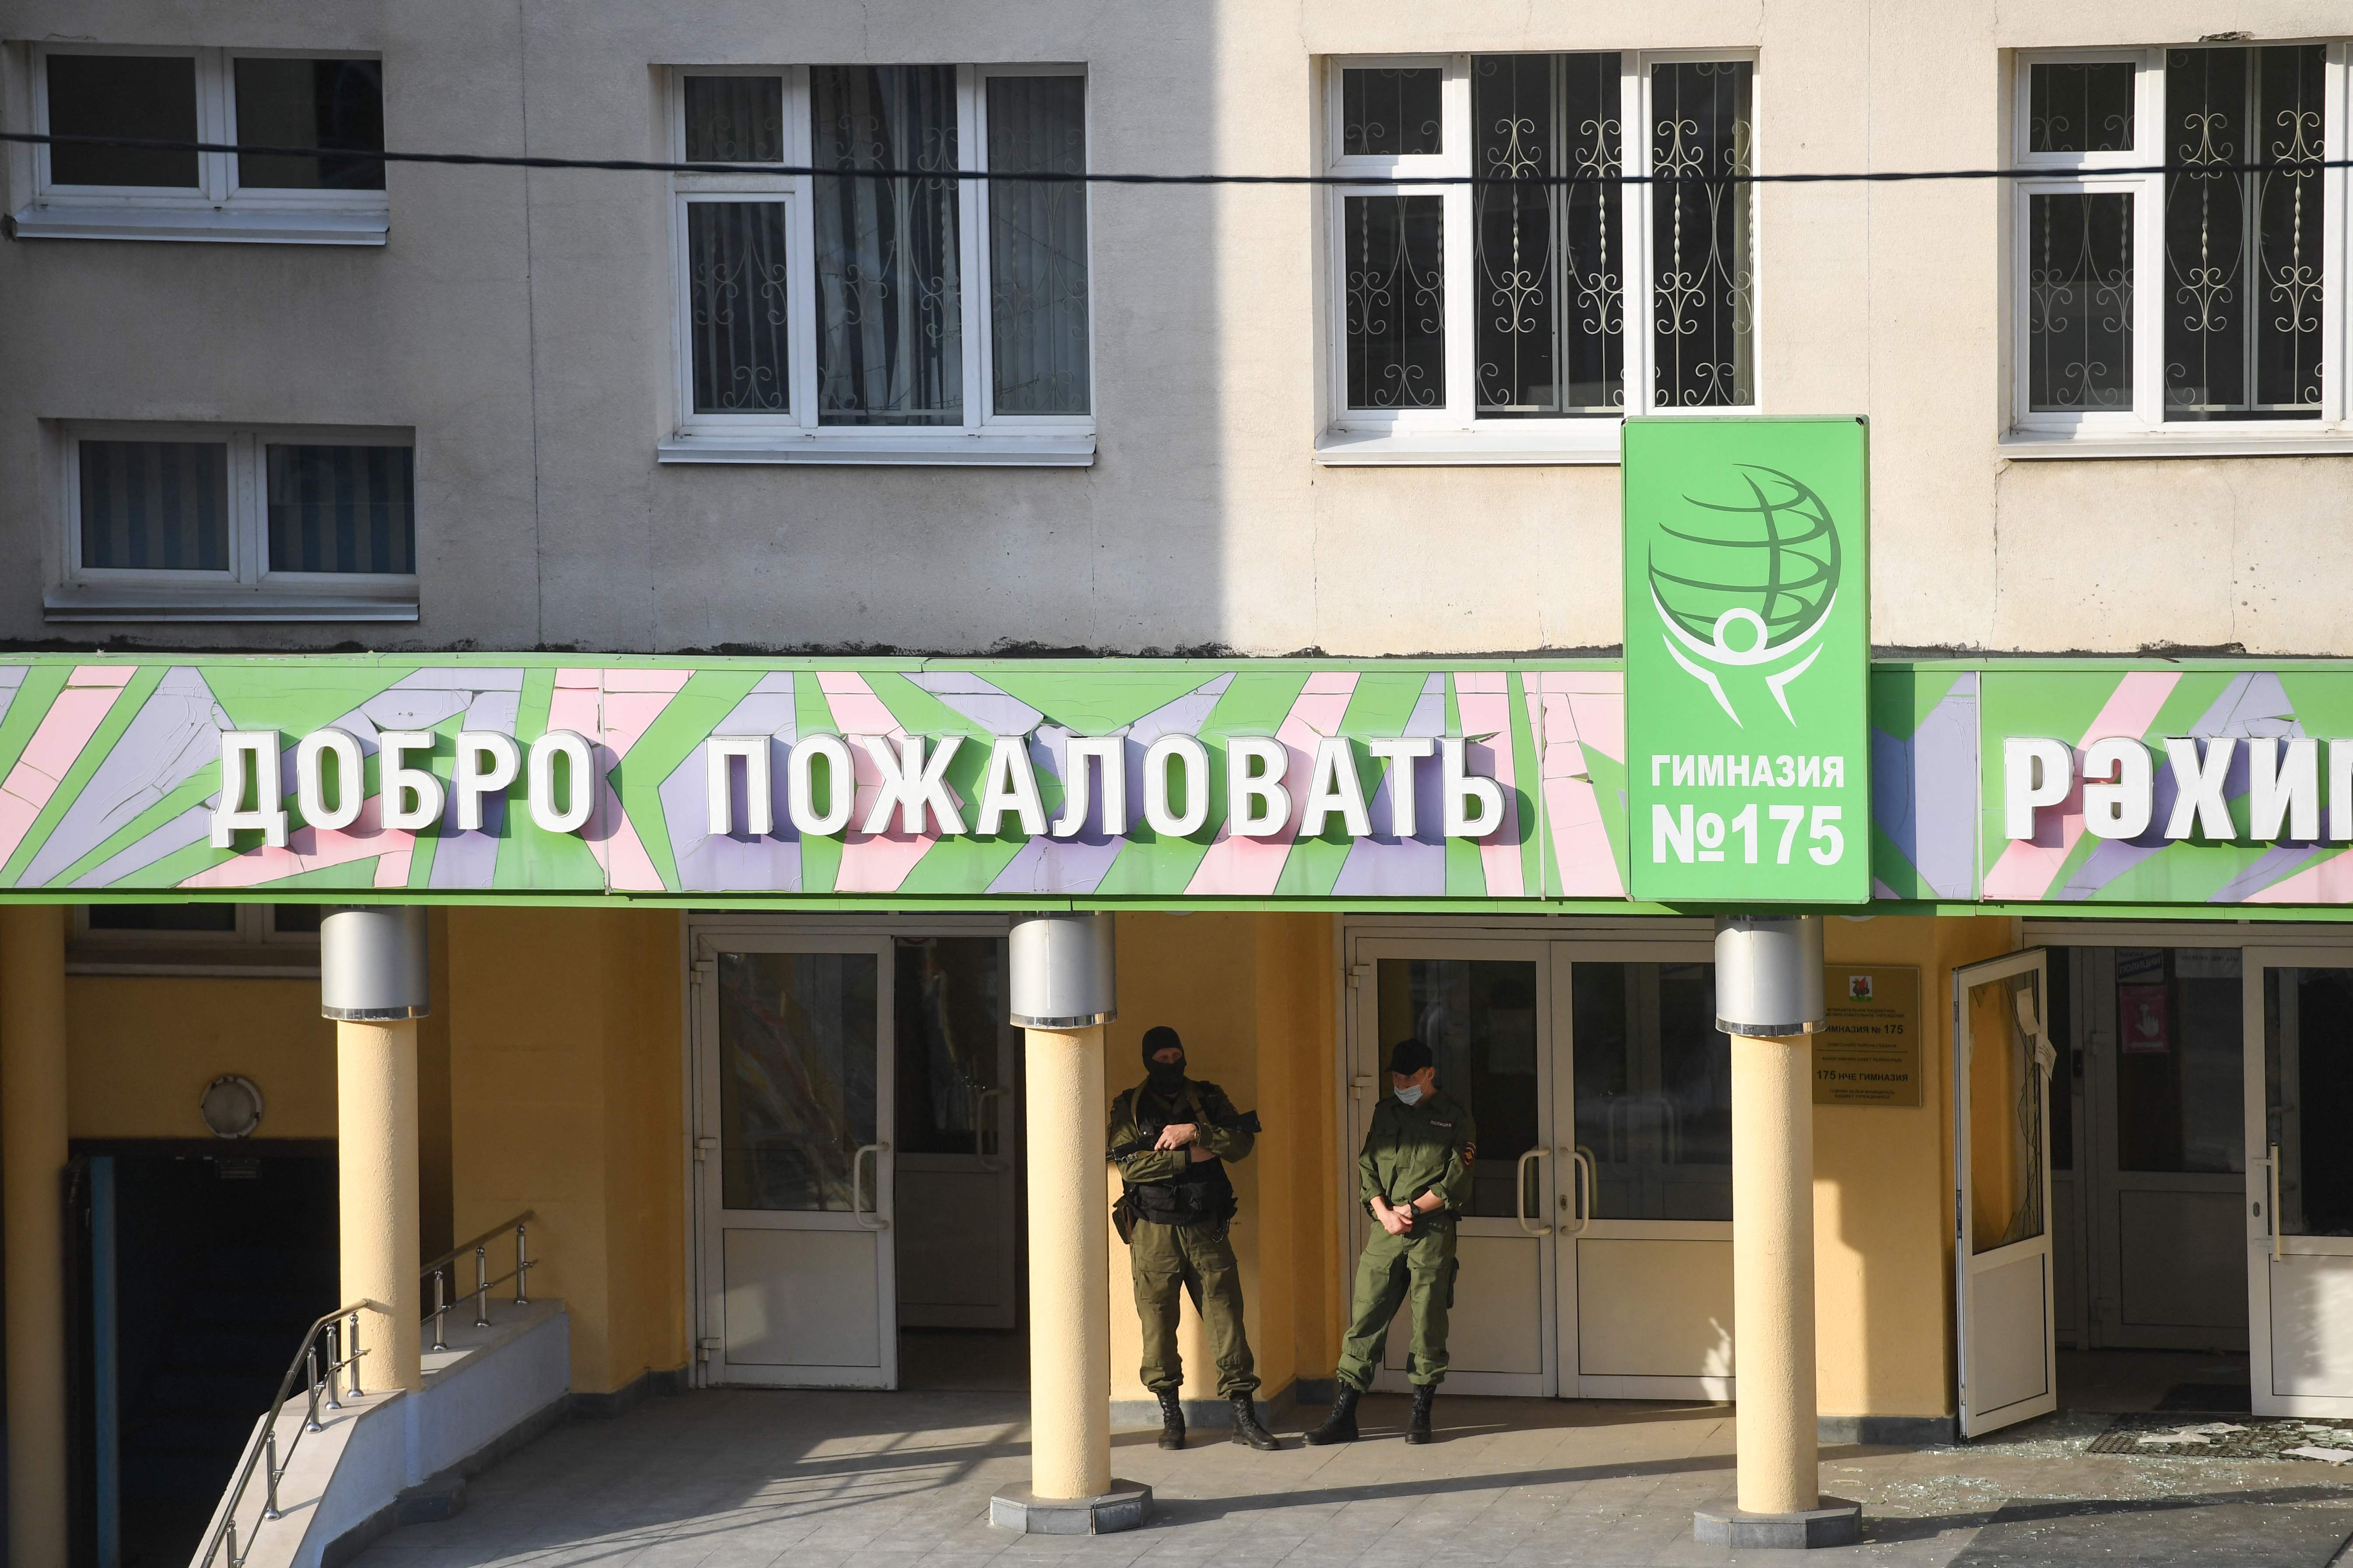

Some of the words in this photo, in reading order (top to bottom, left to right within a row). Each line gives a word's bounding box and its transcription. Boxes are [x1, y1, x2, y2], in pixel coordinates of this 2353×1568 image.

[1651, 755, 1844, 787] ГИМНАЗИЯ
[210, 729, 596, 848] ДОБРО
[705, 733, 1506, 838] ПОЖАЛОВАТЬ
[1652, 803, 1844, 866] №175
[2120, 956, 2160, 974] ПОЛИЦИИ
[1884, 1024, 1903, 1034] 175
[1817, 1070, 1836, 1080] 175
